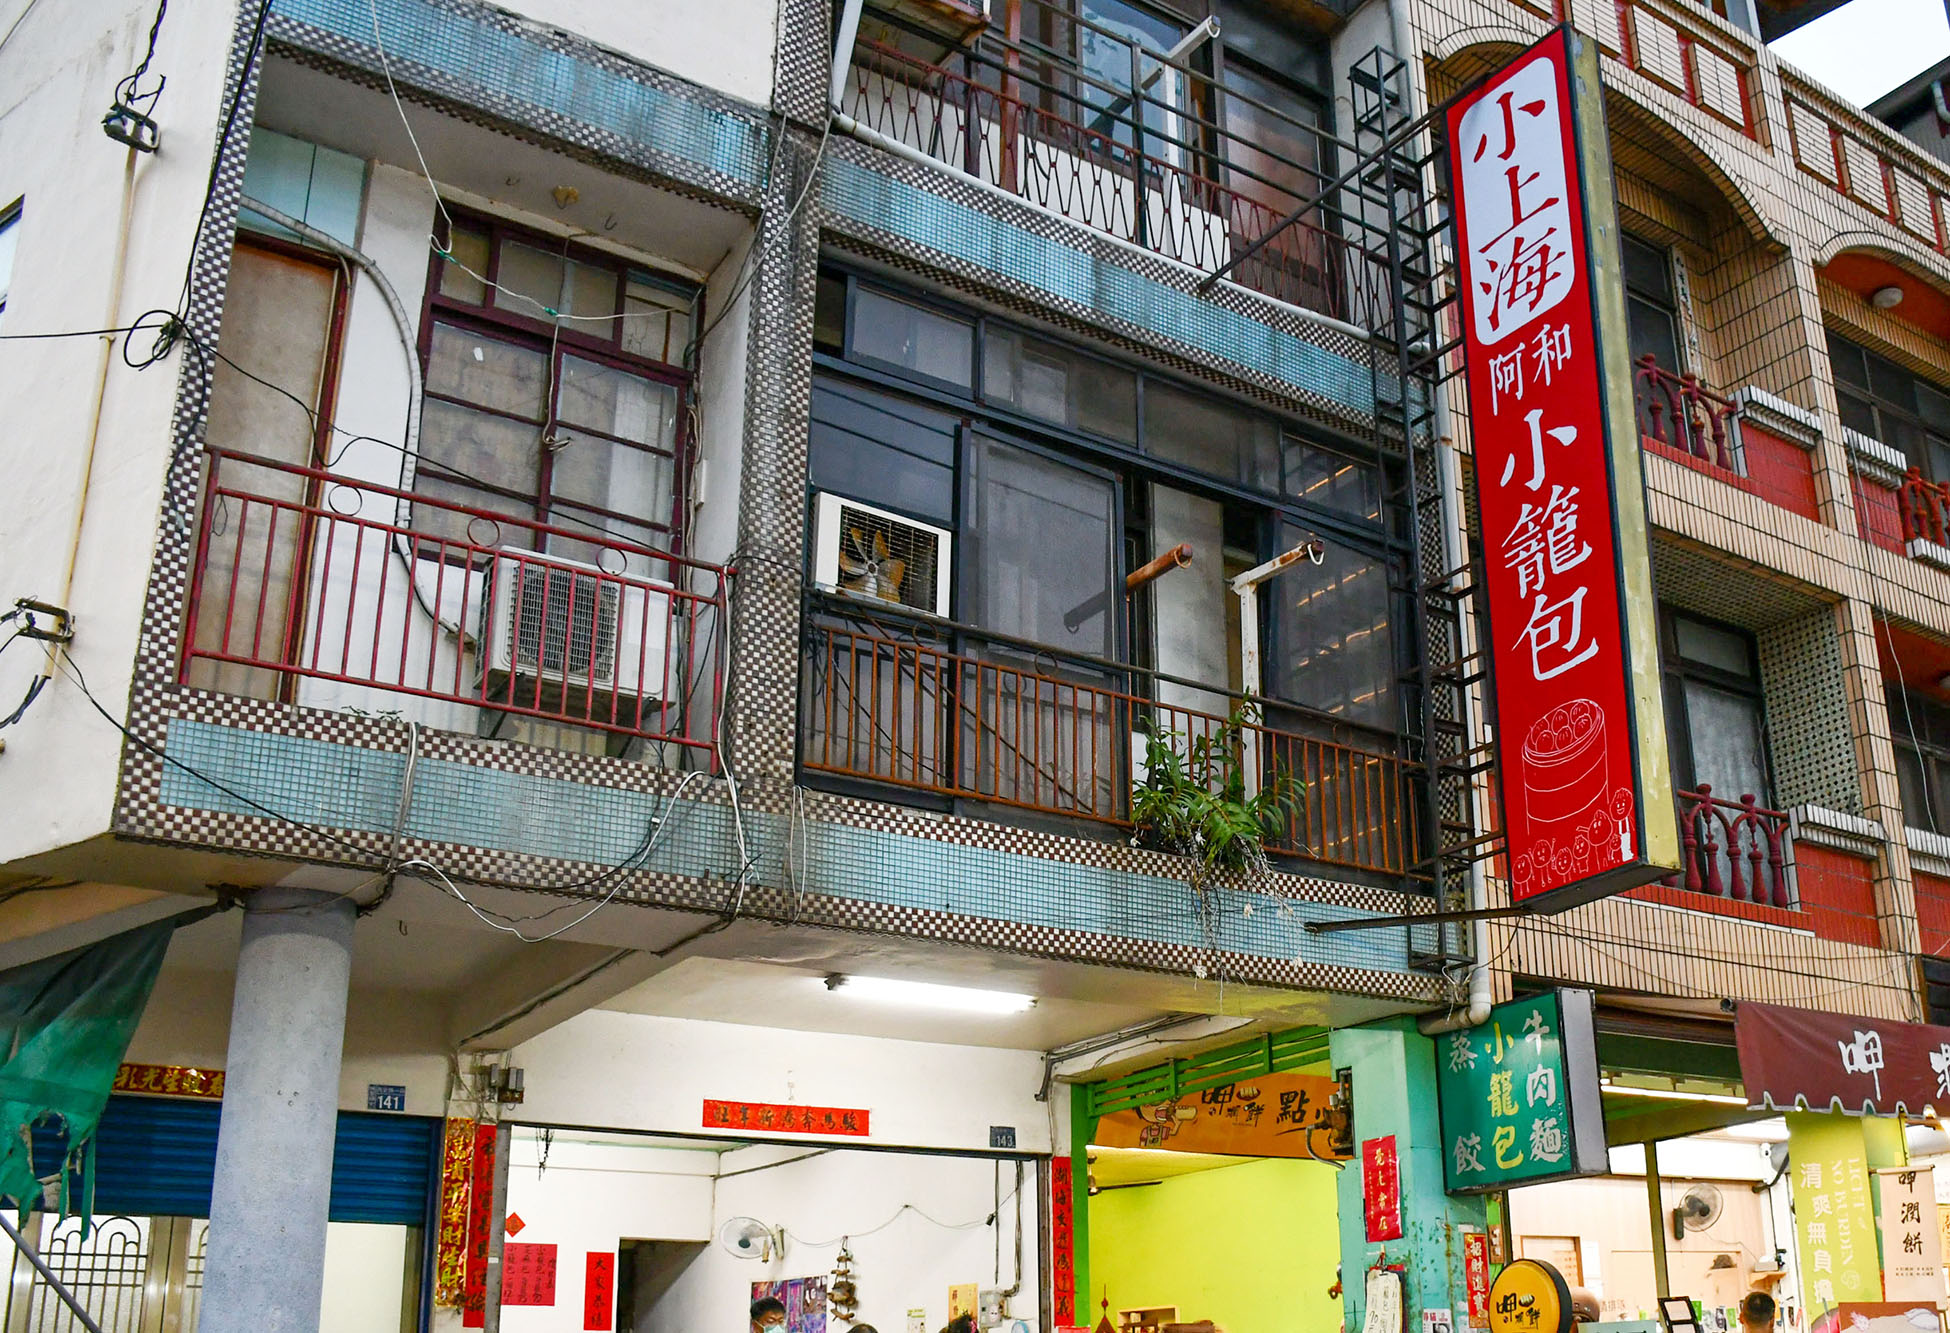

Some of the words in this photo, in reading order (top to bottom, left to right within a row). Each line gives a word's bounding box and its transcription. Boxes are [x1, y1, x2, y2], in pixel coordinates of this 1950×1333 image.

[1473, 91, 1566, 332] 小上海
[1489, 323, 1572, 416] 阿和
[1500, 408, 1600, 681] 小籠包
[378, 1095, 399, 1110] 141
[996, 1135, 1014, 1147] 143
[1448, 1029, 1486, 1176] 蒸餃
[1485, 1022, 1524, 1169] 小籠包
[1522, 1009, 1564, 1163] 牛肉麵
[1800, 1162, 1834, 1304] 清爽無負擔
[1898, 1170, 1924, 1256] 呷潤餅
